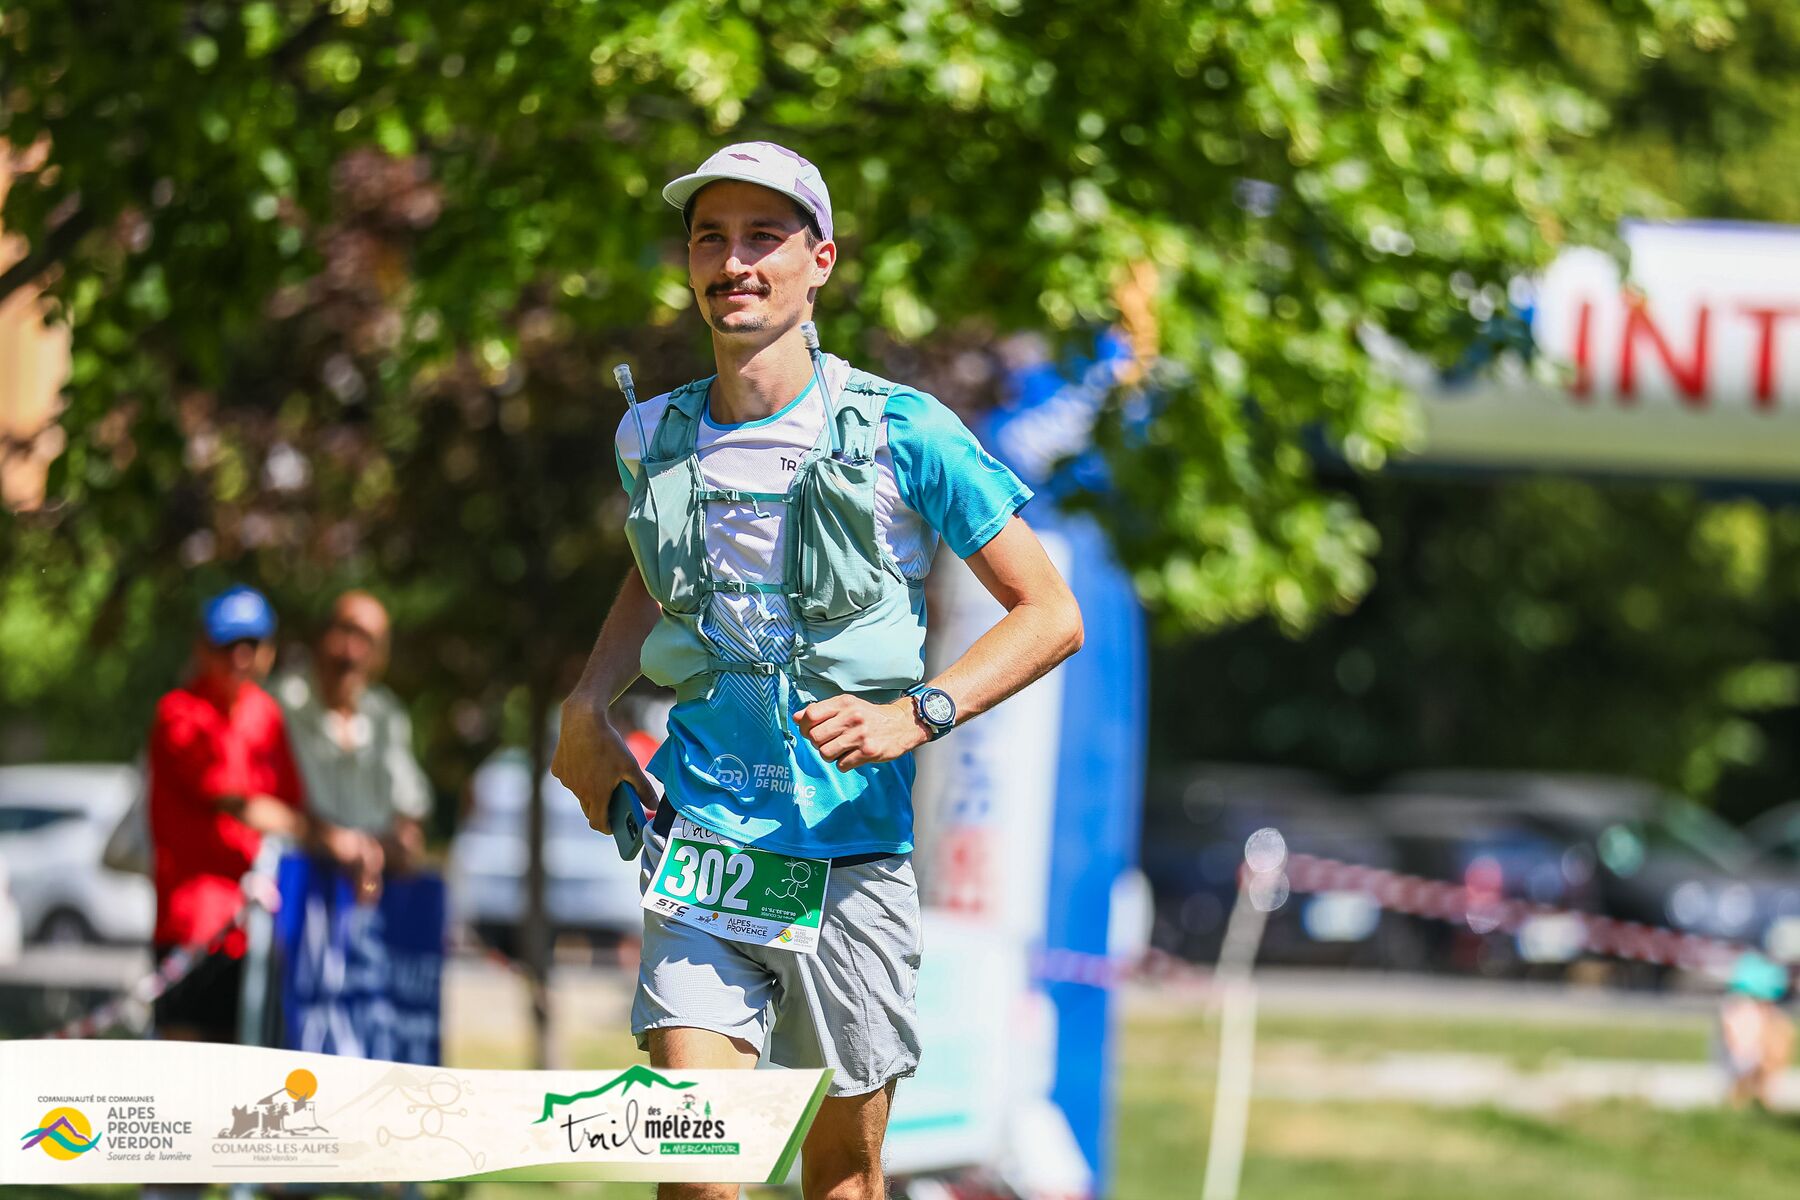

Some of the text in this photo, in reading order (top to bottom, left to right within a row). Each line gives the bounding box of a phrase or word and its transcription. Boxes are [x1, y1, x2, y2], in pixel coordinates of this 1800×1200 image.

[752, 764, 790, 779] TERRE
[755, 779, 769, 788] DE
[664, 845, 755, 911] 302
[655, 898, 690, 915] STC
[728, 917, 751, 928] ALPES
[726, 924, 768, 937] PROVENCE
